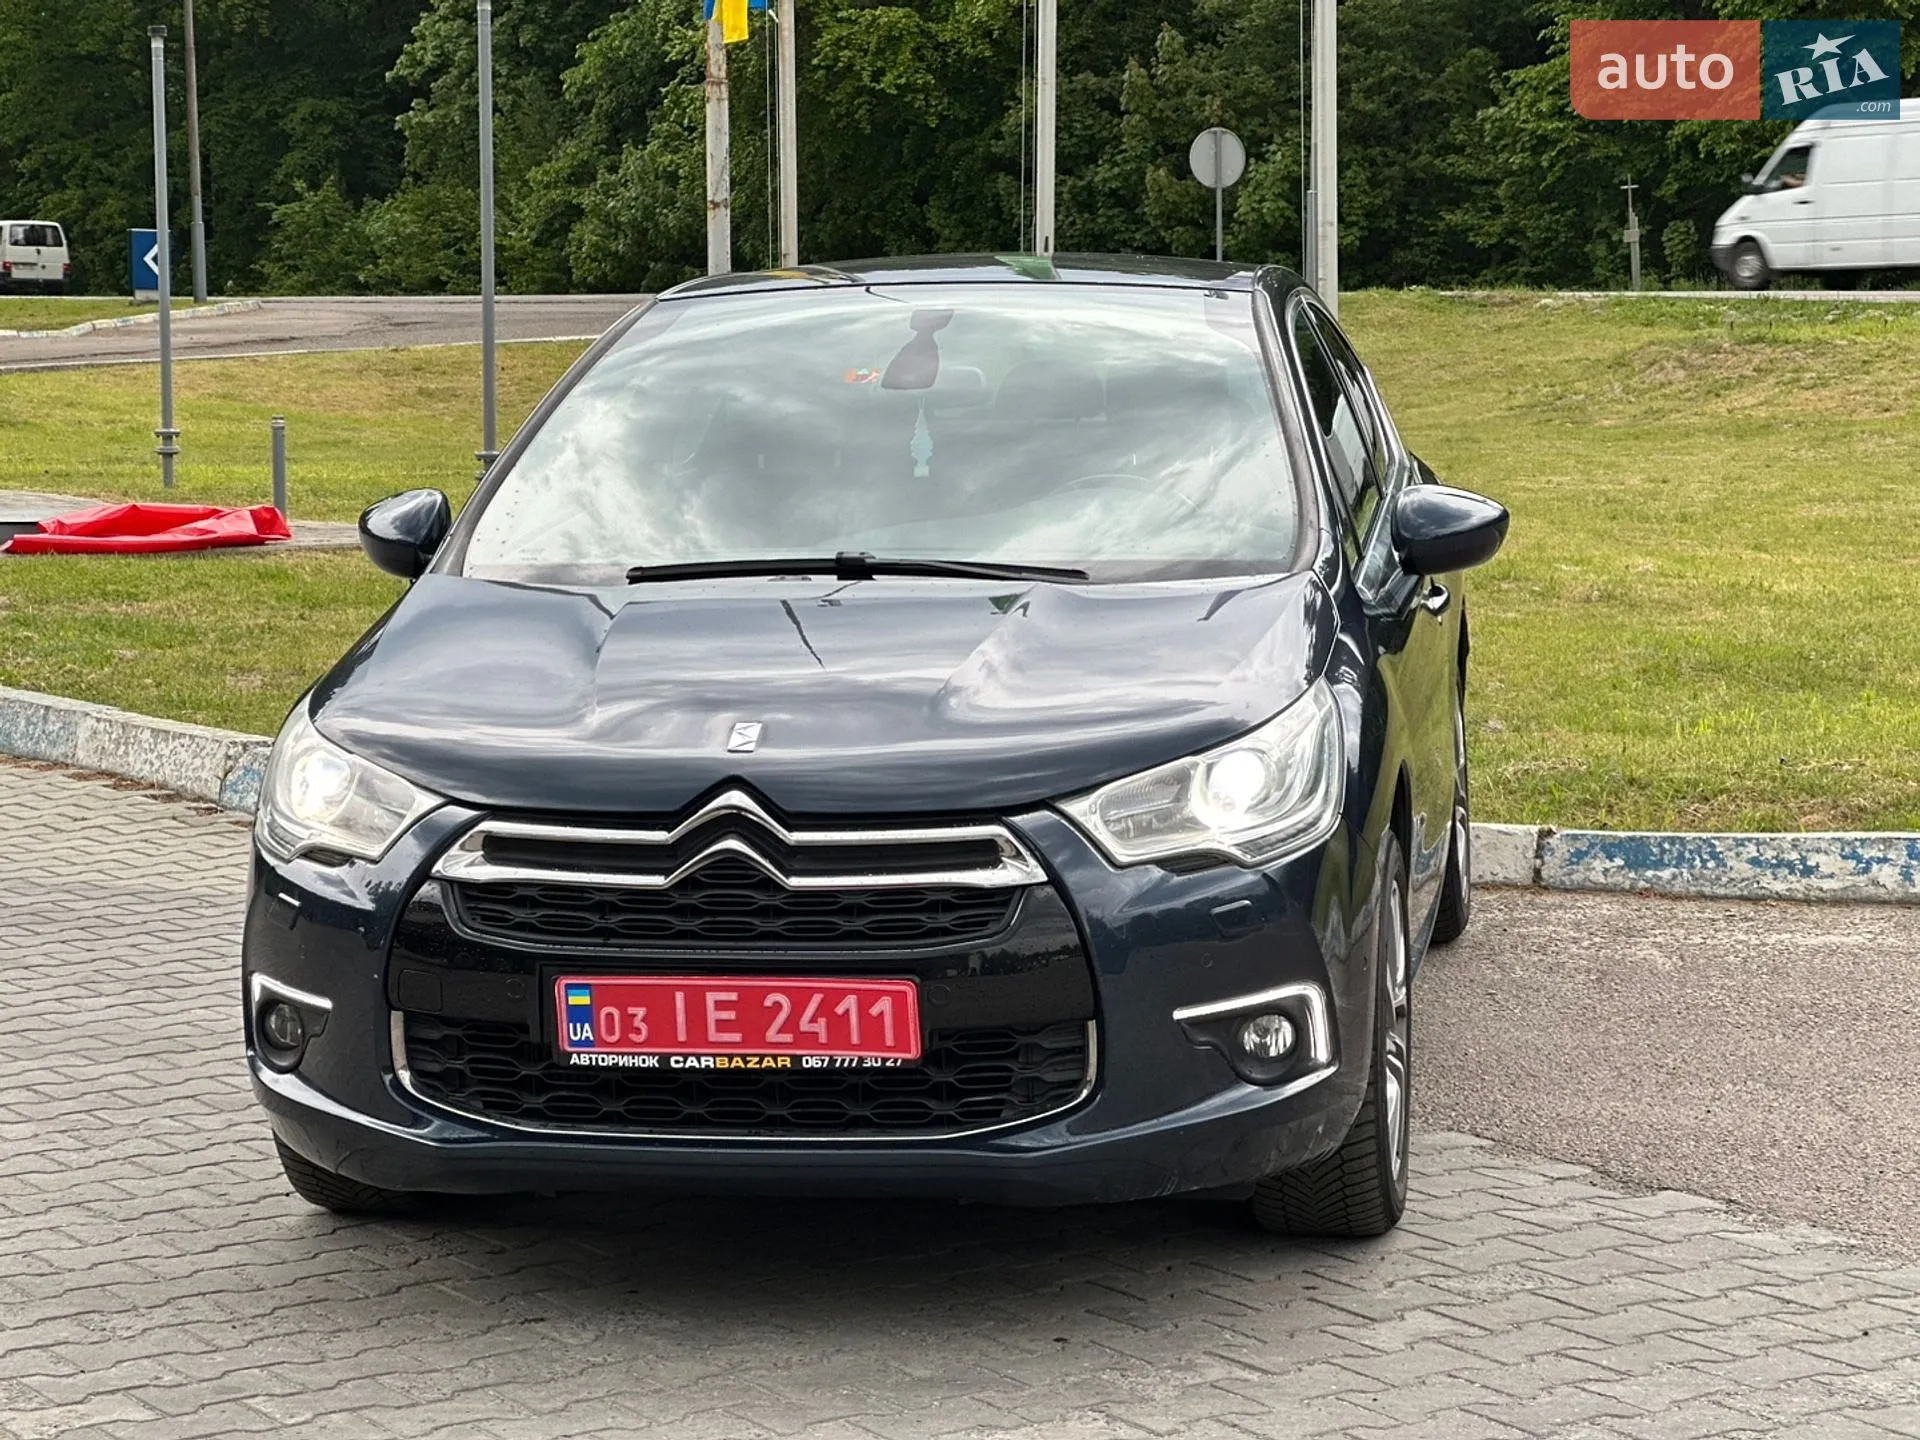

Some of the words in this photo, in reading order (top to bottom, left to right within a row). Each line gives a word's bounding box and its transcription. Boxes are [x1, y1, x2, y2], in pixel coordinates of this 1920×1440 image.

[600, 1006, 648, 1044] 03
[674, 991, 743, 1043] IE
[763, 993, 896, 1047] 2411
[569, 1022, 594, 1041] UA
[569, 1053, 660, 1068] АВТОРИНОК
[670, 1056, 792, 1069] CARBAZAR
[802, 1056, 829, 1068] 067
[833, 1056, 858, 1068] 777
